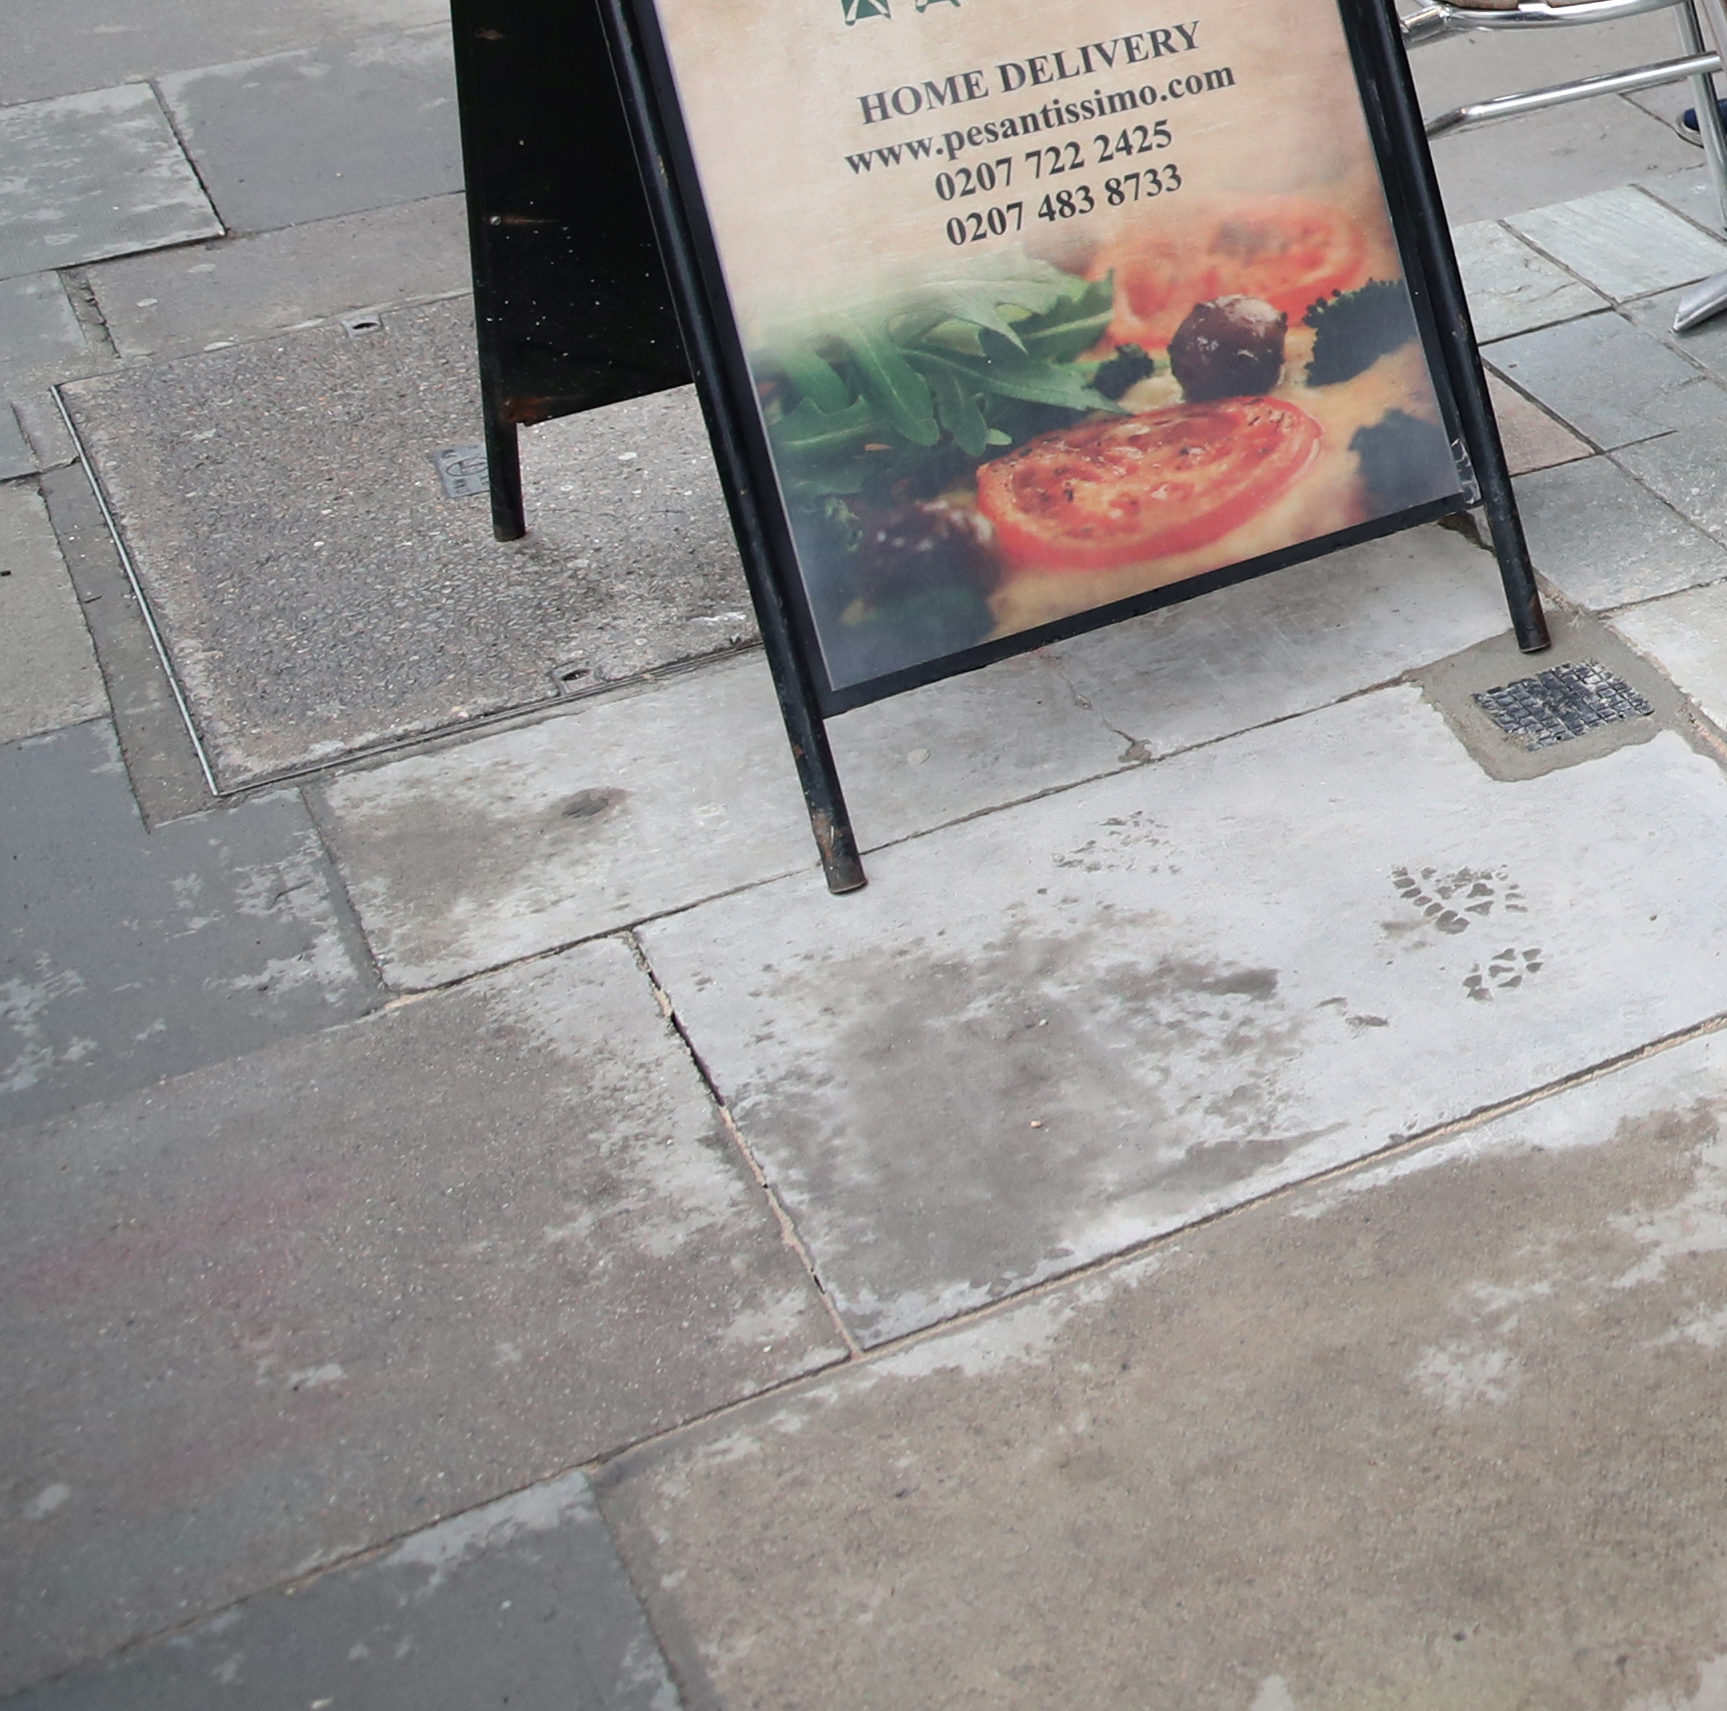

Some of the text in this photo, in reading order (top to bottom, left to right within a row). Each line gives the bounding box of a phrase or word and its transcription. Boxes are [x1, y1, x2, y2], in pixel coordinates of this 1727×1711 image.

[844, 61, 1237, 176] www.pesantissimo.com
[857, 19, 1201, 126] HOME DELIVERY
[934, 119, 1174, 202] 0207 722 2425
[945, 162, 1183, 247] 0207 483 8733
